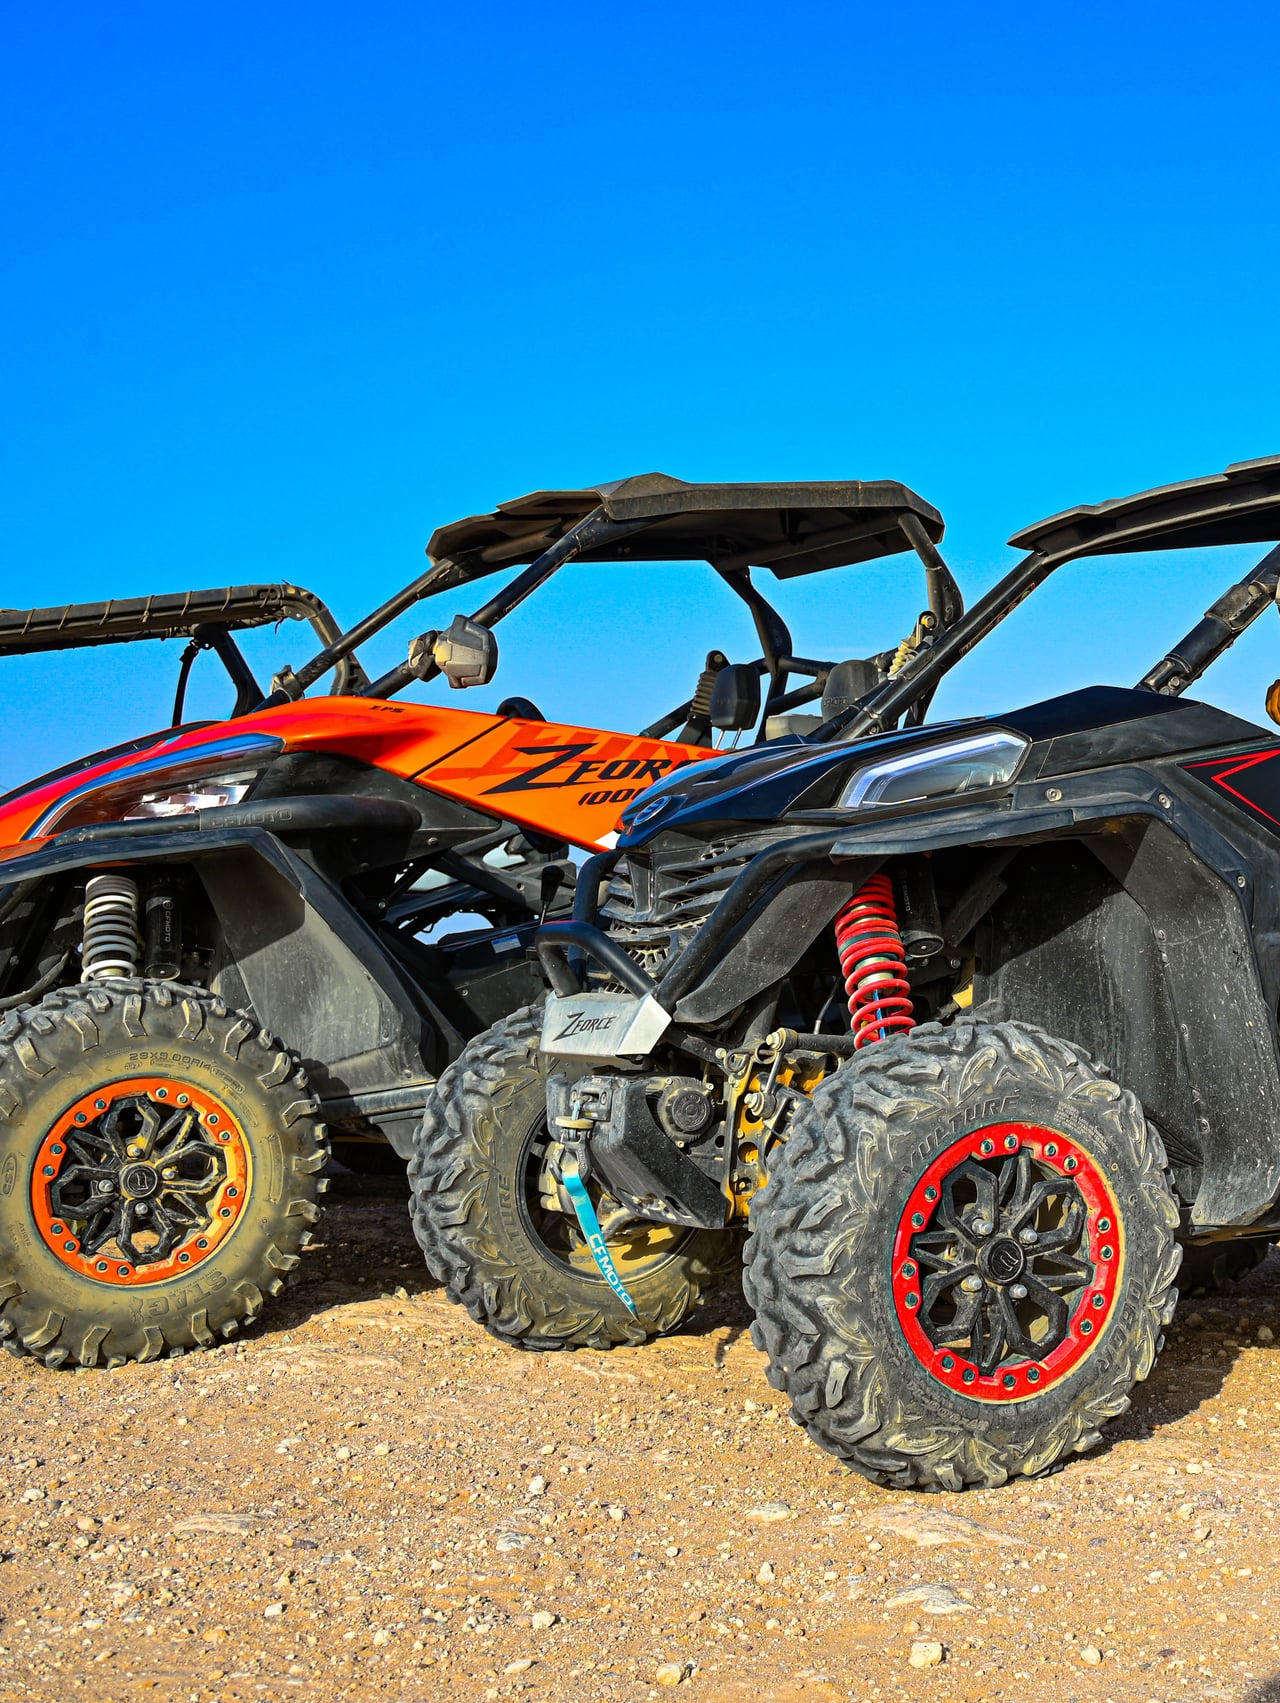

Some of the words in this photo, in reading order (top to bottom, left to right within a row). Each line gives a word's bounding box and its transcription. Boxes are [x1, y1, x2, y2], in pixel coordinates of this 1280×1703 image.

[478, 742, 692, 796] ZFOR
[210, 807, 293, 829] CFMOTO
[551, 1010, 617, 1042] ZFORCE
[589, 1233, 634, 1306] CFMOTO
